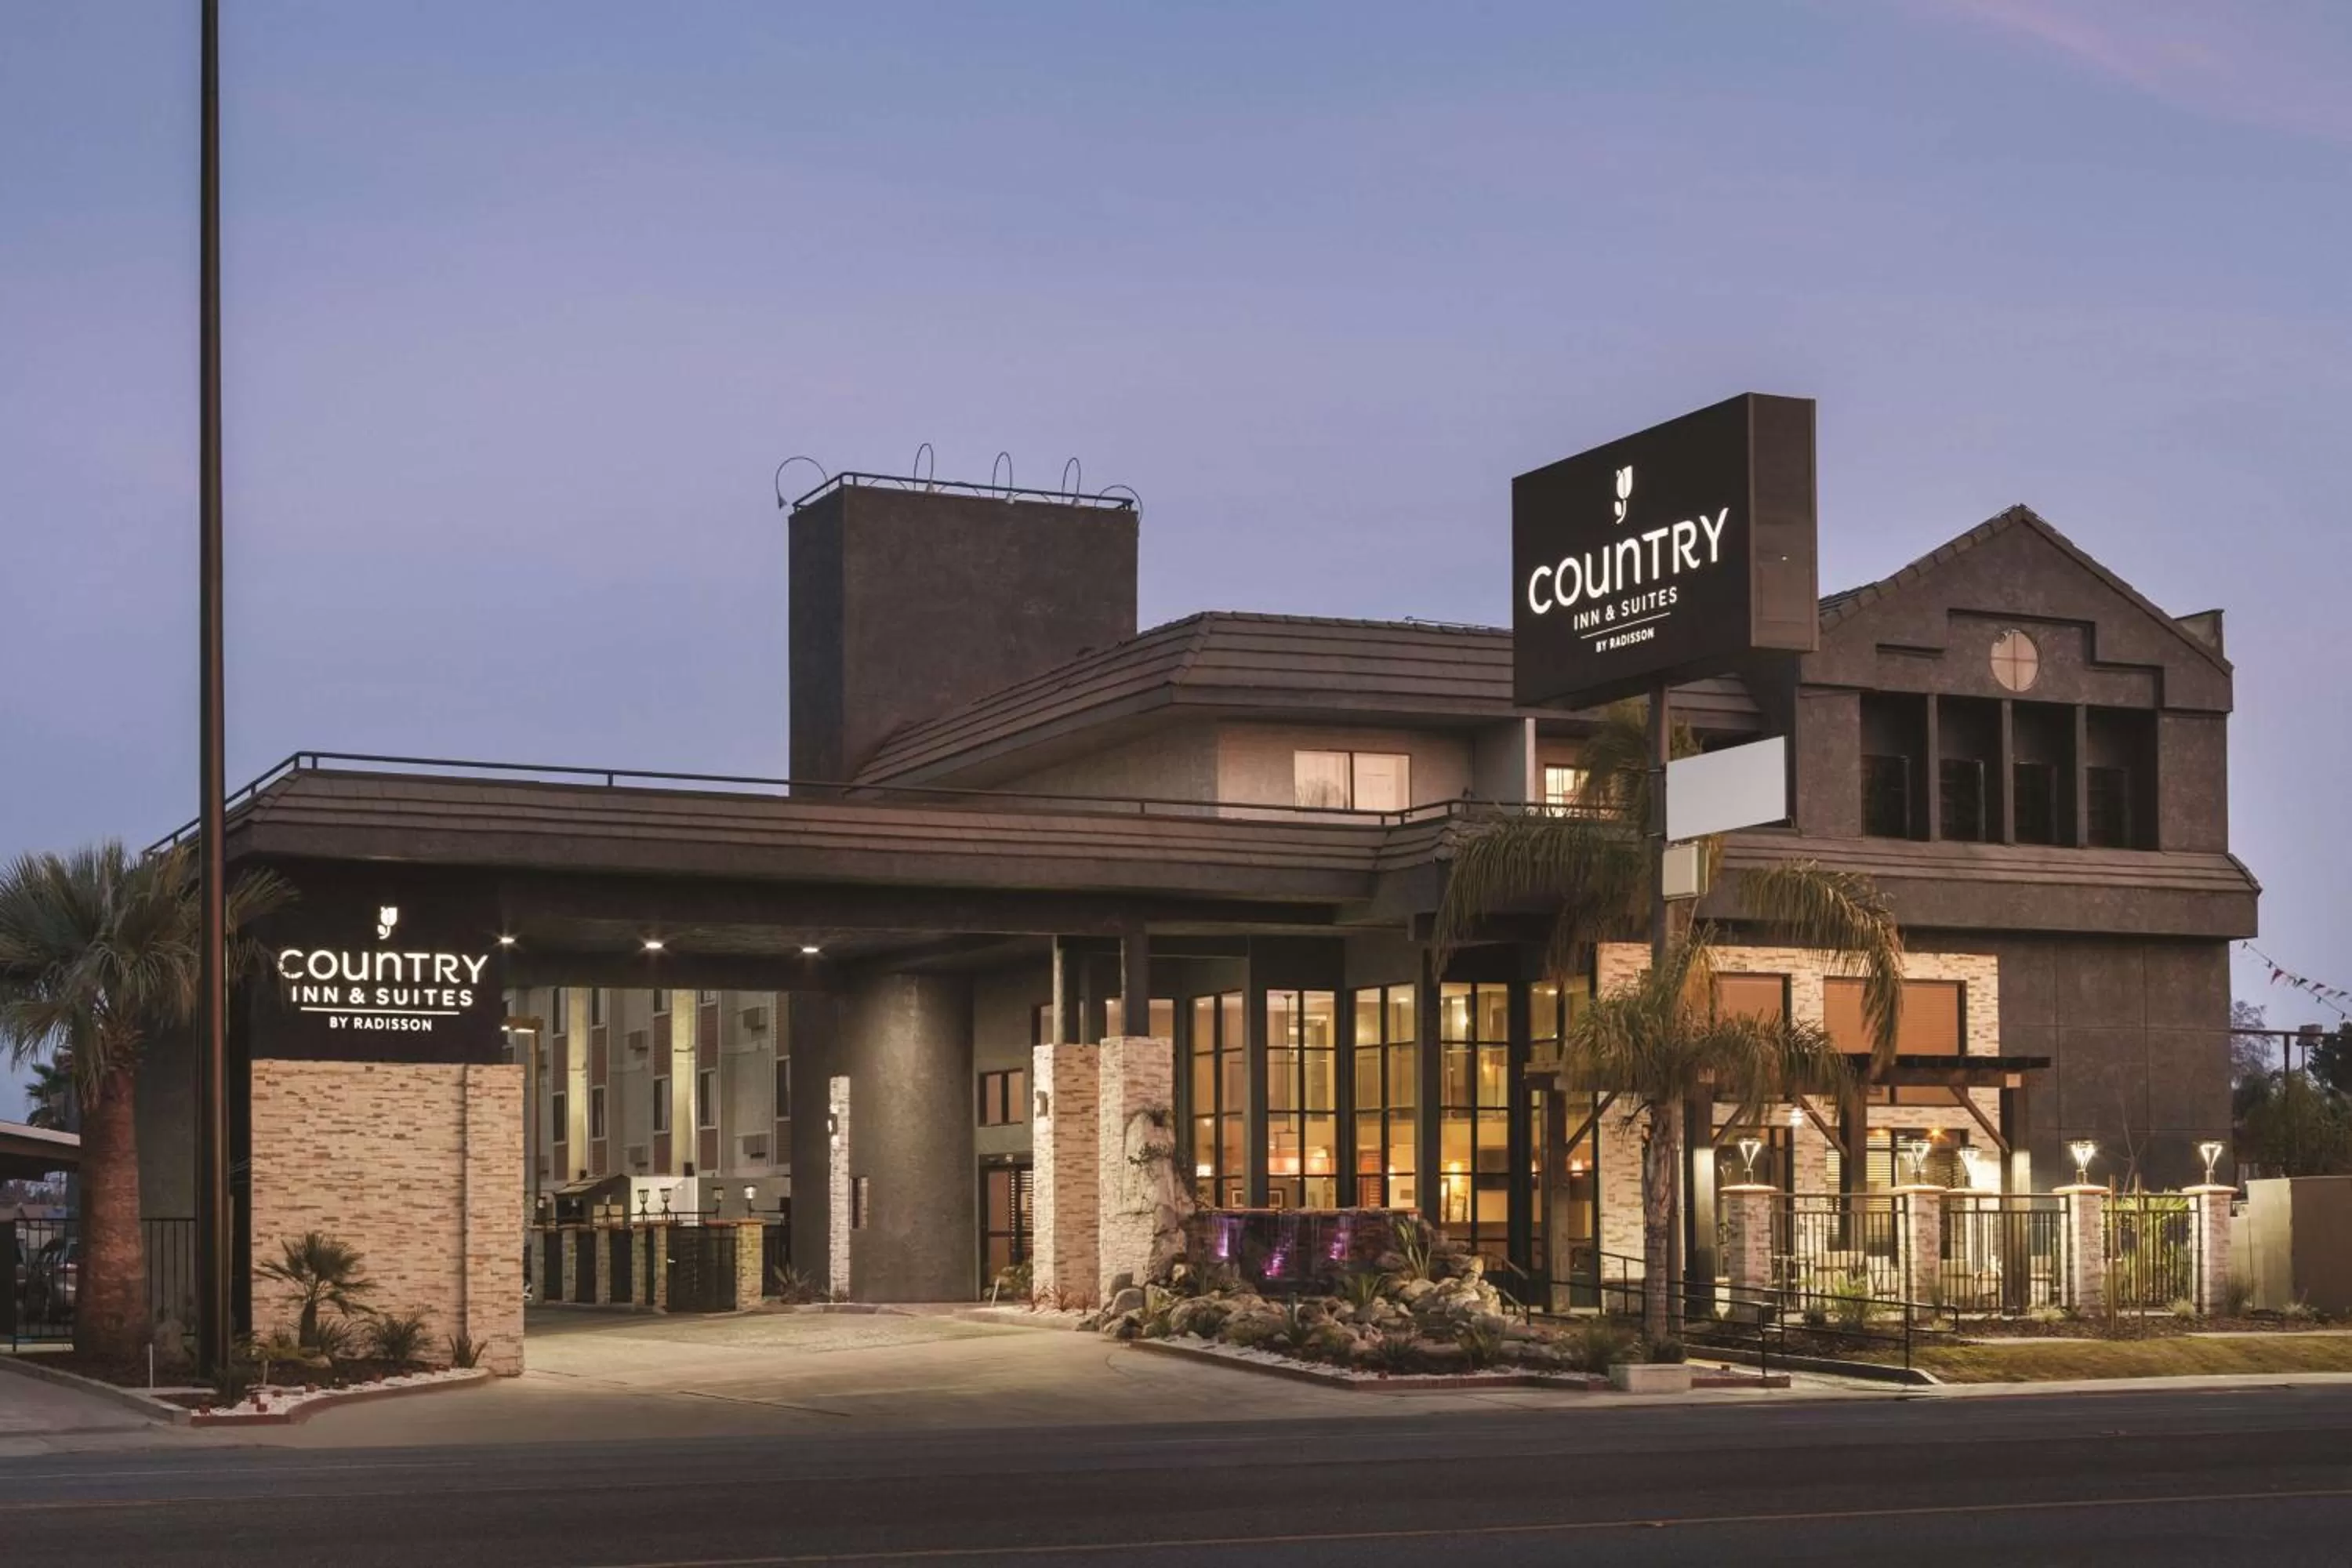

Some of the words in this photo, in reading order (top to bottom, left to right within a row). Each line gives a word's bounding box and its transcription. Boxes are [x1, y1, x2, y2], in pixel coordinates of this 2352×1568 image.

[1573, 608, 1600, 631] INN
[1605, 604, 1616, 622] &
[1621, 586, 1678, 617] SUITES
[1595, 639, 1607, 653] BY
[1610, 626, 1654, 649] RADISSON
[291, 985, 339, 1004] INN
[348, 986, 366, 1004] &
[376, 987, 474, 1007] SUITES
[329, 1015, 349, 1029] BY
[353, 1016, 432, 1032] RADISSON
